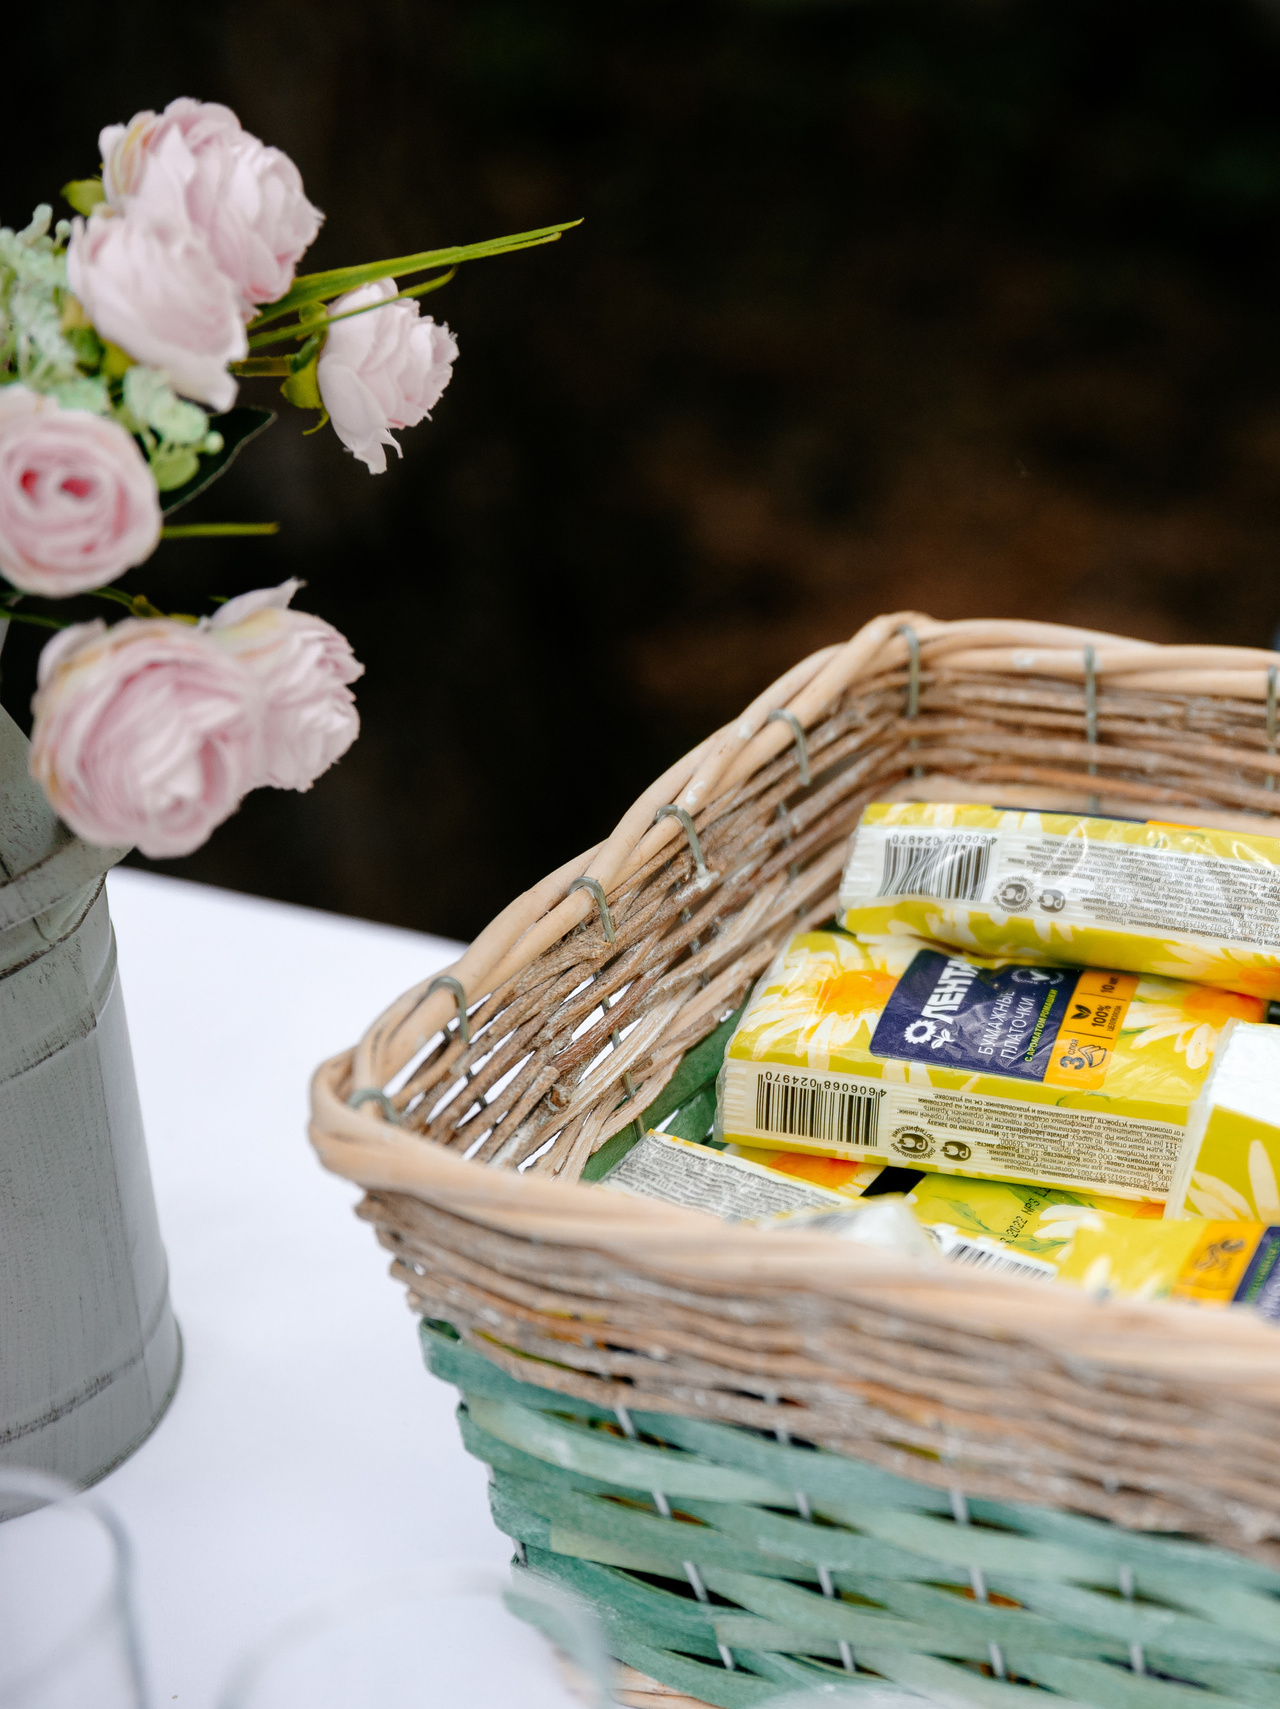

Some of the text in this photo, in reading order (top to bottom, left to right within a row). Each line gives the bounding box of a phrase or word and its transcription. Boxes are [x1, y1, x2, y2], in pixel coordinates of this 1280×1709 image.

[978, 991, 1015, 1055] БУМАЖНЫЕ
[1091, 1005, 1111, 1027] 100%
[1000, 997, 1036, 1061] ПЛАТОЧКИ
[1028, 1016, 1046, 1056] АРОМАТОМ
[1060, 1056, 1085, 1070] 3
[765, 1071, 817, 1088] 024970
[989, 1121, 1069, 1141] private.label@lenta.com
[1006, 1216, 1028, 1238] 2022
